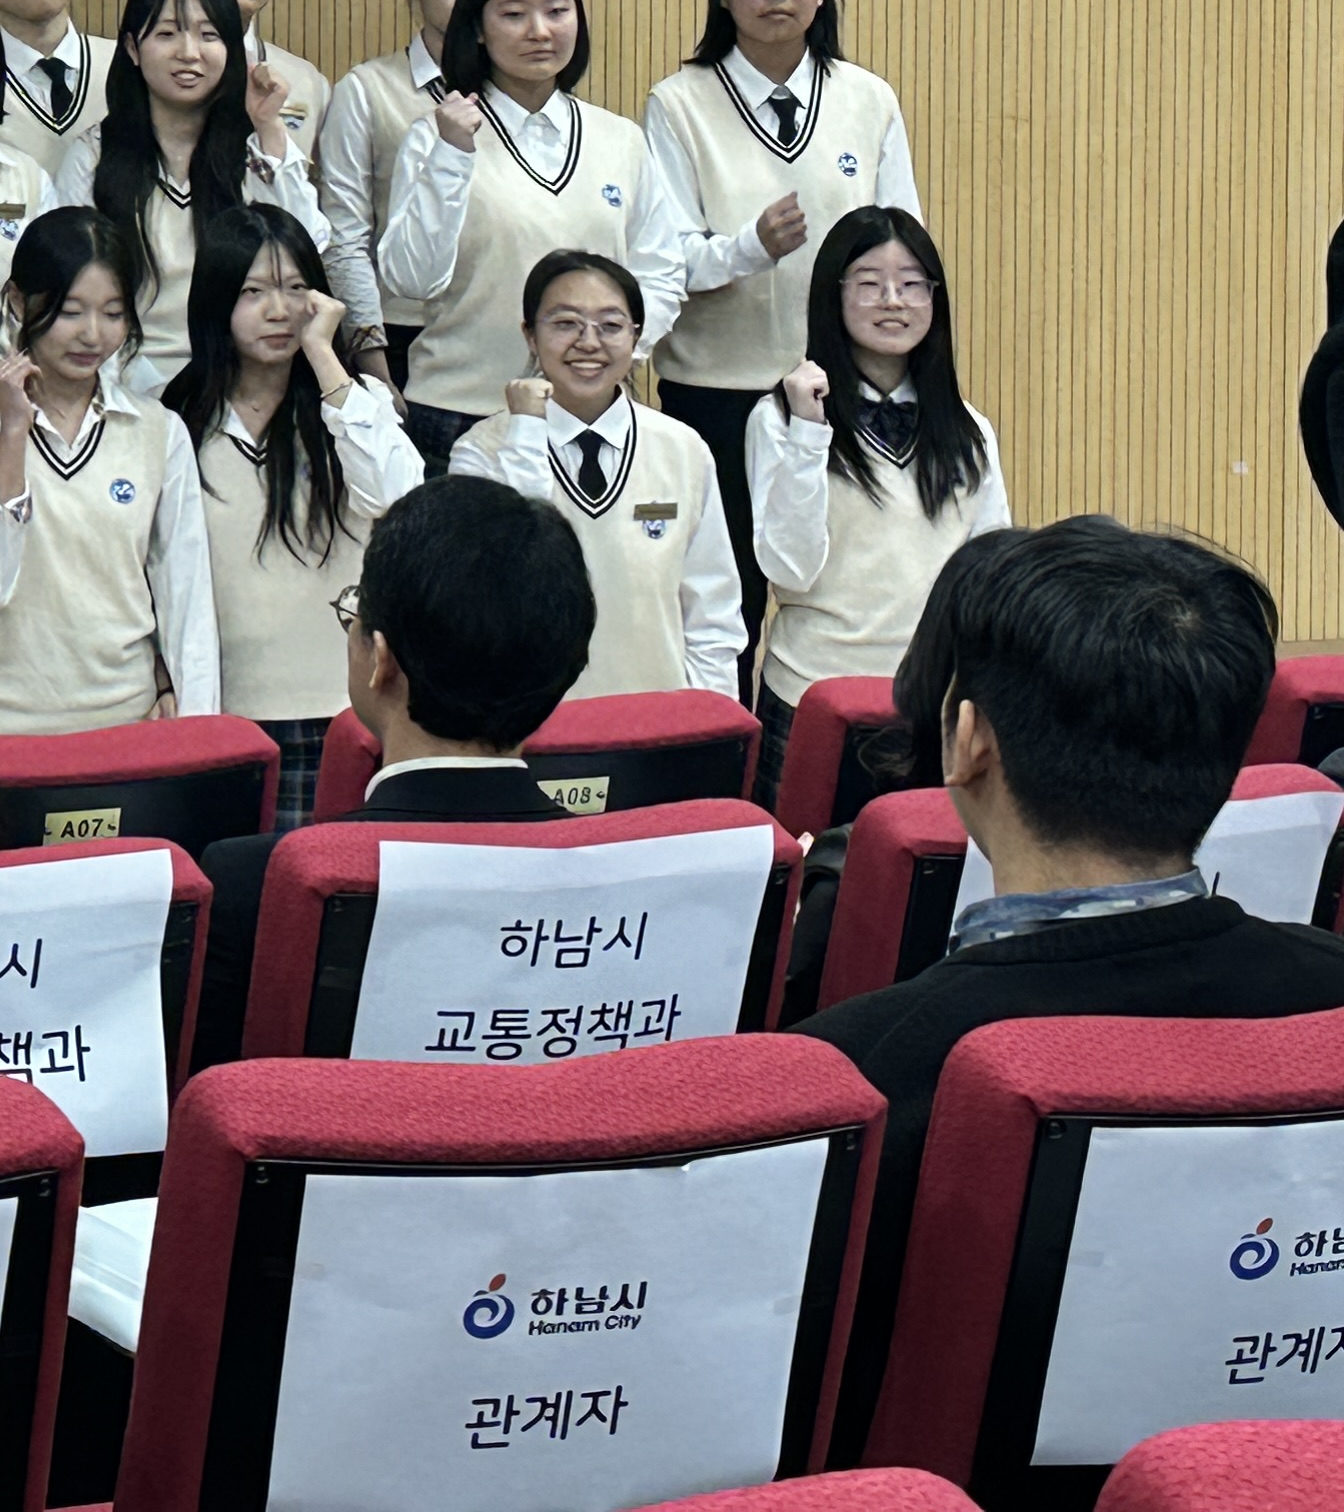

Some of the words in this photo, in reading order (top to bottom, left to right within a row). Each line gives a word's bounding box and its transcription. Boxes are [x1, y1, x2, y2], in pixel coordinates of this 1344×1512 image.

[554, 787, 591, 805] A08
[61, 819, 103, 838] A07
[500, 912, 647, 968] 하남시
[425, 993, 682, 1060] 교통정책과
[531, 1281, 647, 1316] 하남시
[529, 1320, 600, 1335] Hanam
[605, 1315, 641, 1329] City
[465, 1385, 628, 1449] 관계자
